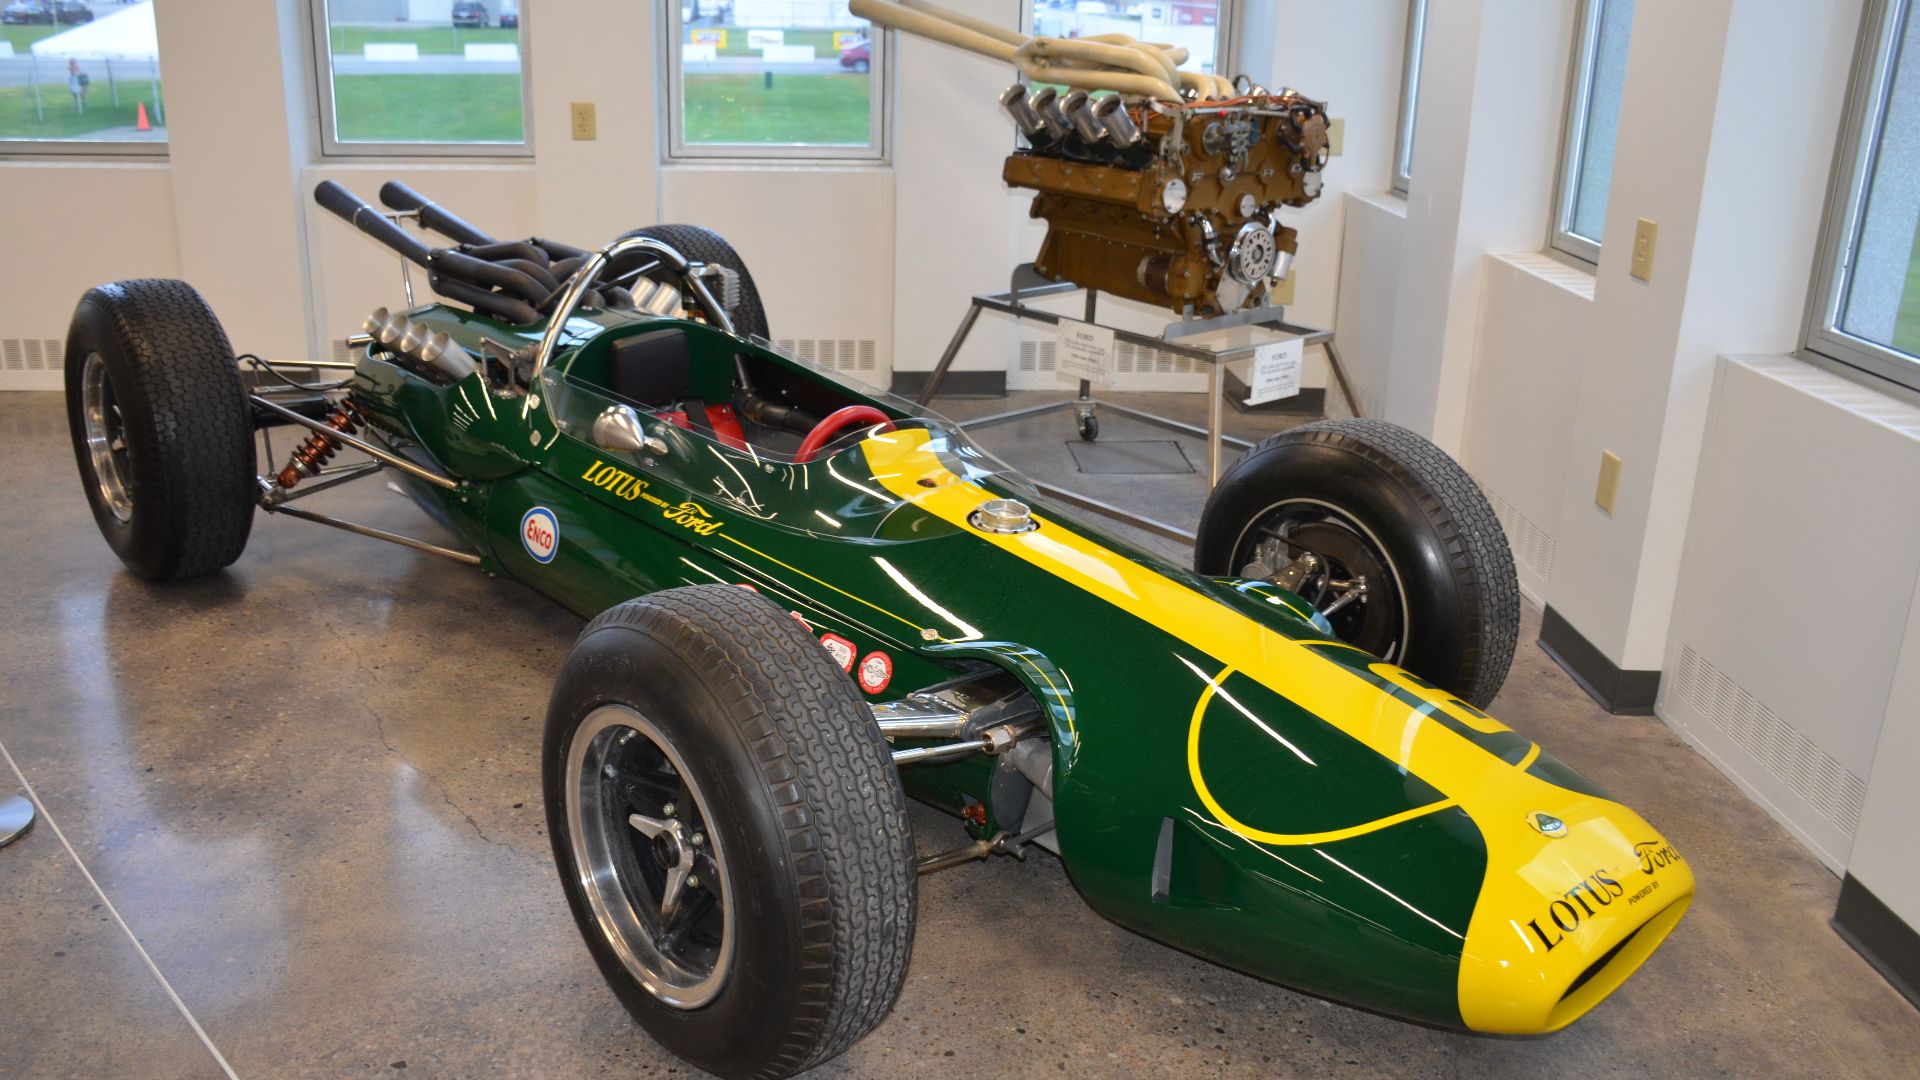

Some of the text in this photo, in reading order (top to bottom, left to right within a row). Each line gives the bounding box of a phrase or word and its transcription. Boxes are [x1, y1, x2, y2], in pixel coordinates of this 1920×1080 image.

[581, 460, 650, 501] LOTUS
[663, 502, 724, 536] Ford
[527, 519, 552, 550] ENCO
[1633, 841, 1681, 875] Ford
[1528, 868, 1624, 952] LOTUS
[1628, 885, 1653, 905] POWERED
